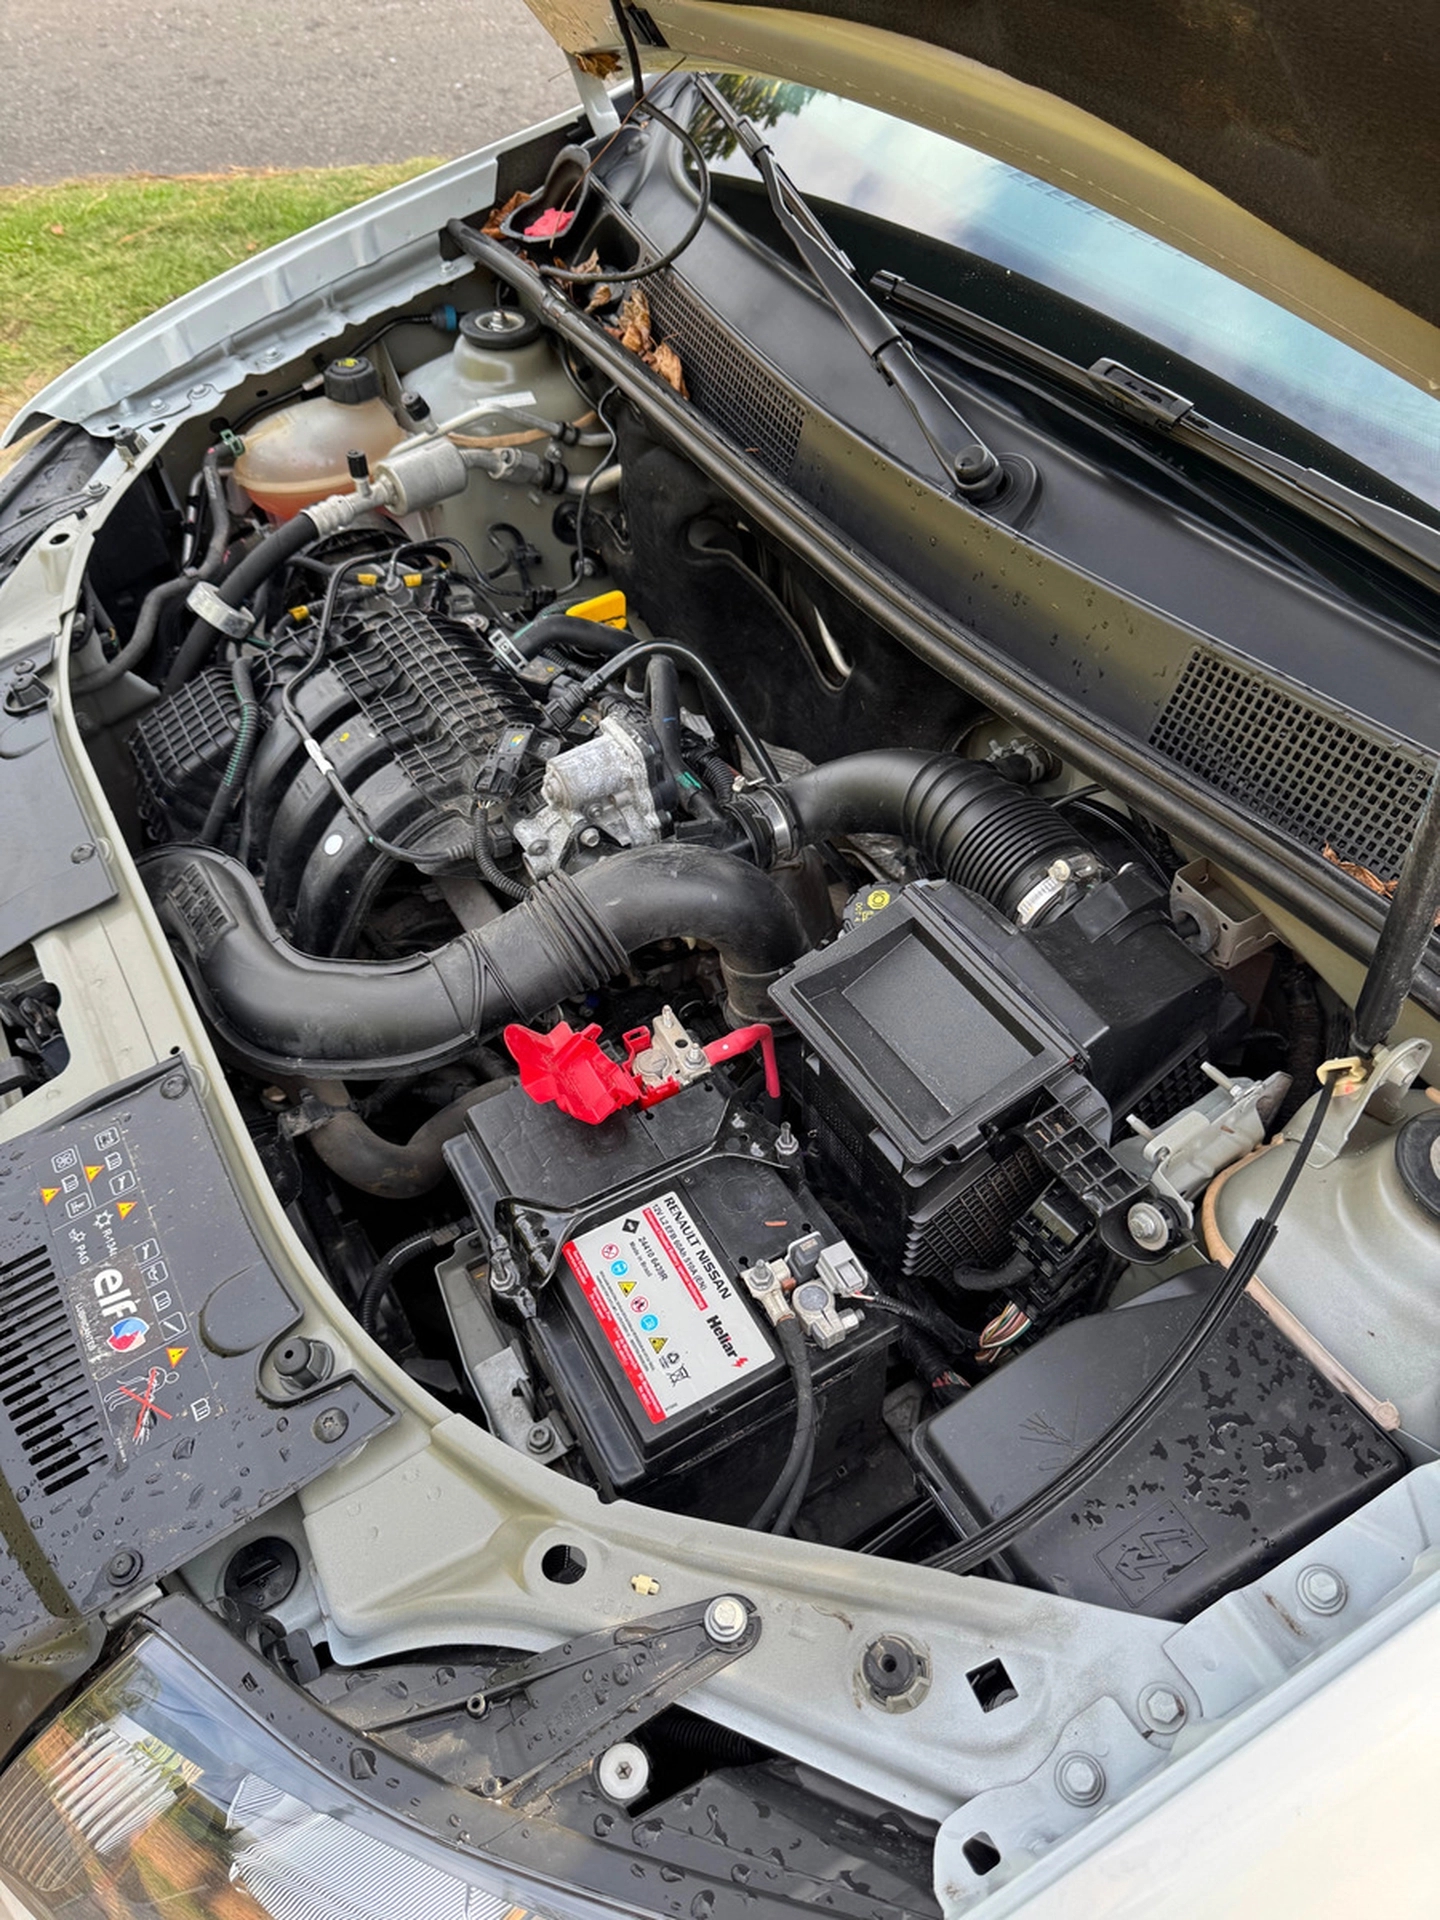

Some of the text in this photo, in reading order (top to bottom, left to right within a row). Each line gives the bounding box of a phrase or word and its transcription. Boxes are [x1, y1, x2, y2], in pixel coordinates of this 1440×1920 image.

[629, 1241, 640, 1255] Made
[636, 1254, 644, 1262] in
[640, 1261, 652, 1277] Brasil
[651, 1204, 707, 1291] 12V L2 EFB 60Ah 510A (EN)
[664, 1196, 732, 1300] RENAULT NISSAN
[93, 1268, 138, 1318] elf
[706, 1313, 739, 1360] Heliar
